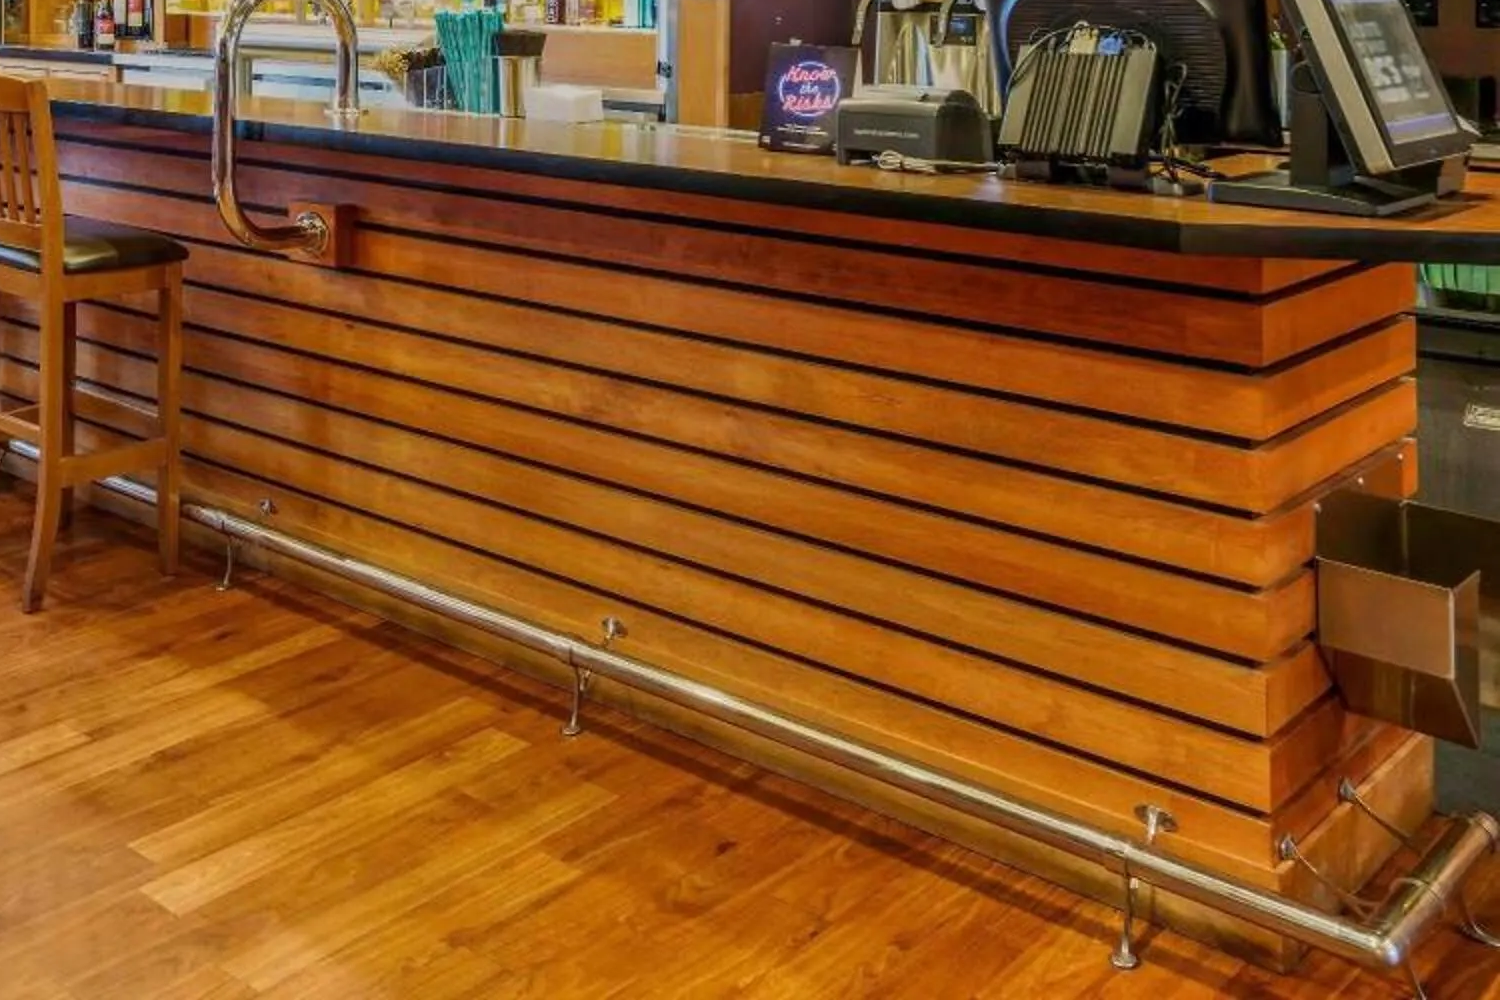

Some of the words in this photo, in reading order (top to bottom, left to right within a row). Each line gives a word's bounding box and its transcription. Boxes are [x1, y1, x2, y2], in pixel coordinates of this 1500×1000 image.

[783, 66, 836, 82] Know
[800, 82, 819, 94] the
[783, 92, 833, 111] Risks
